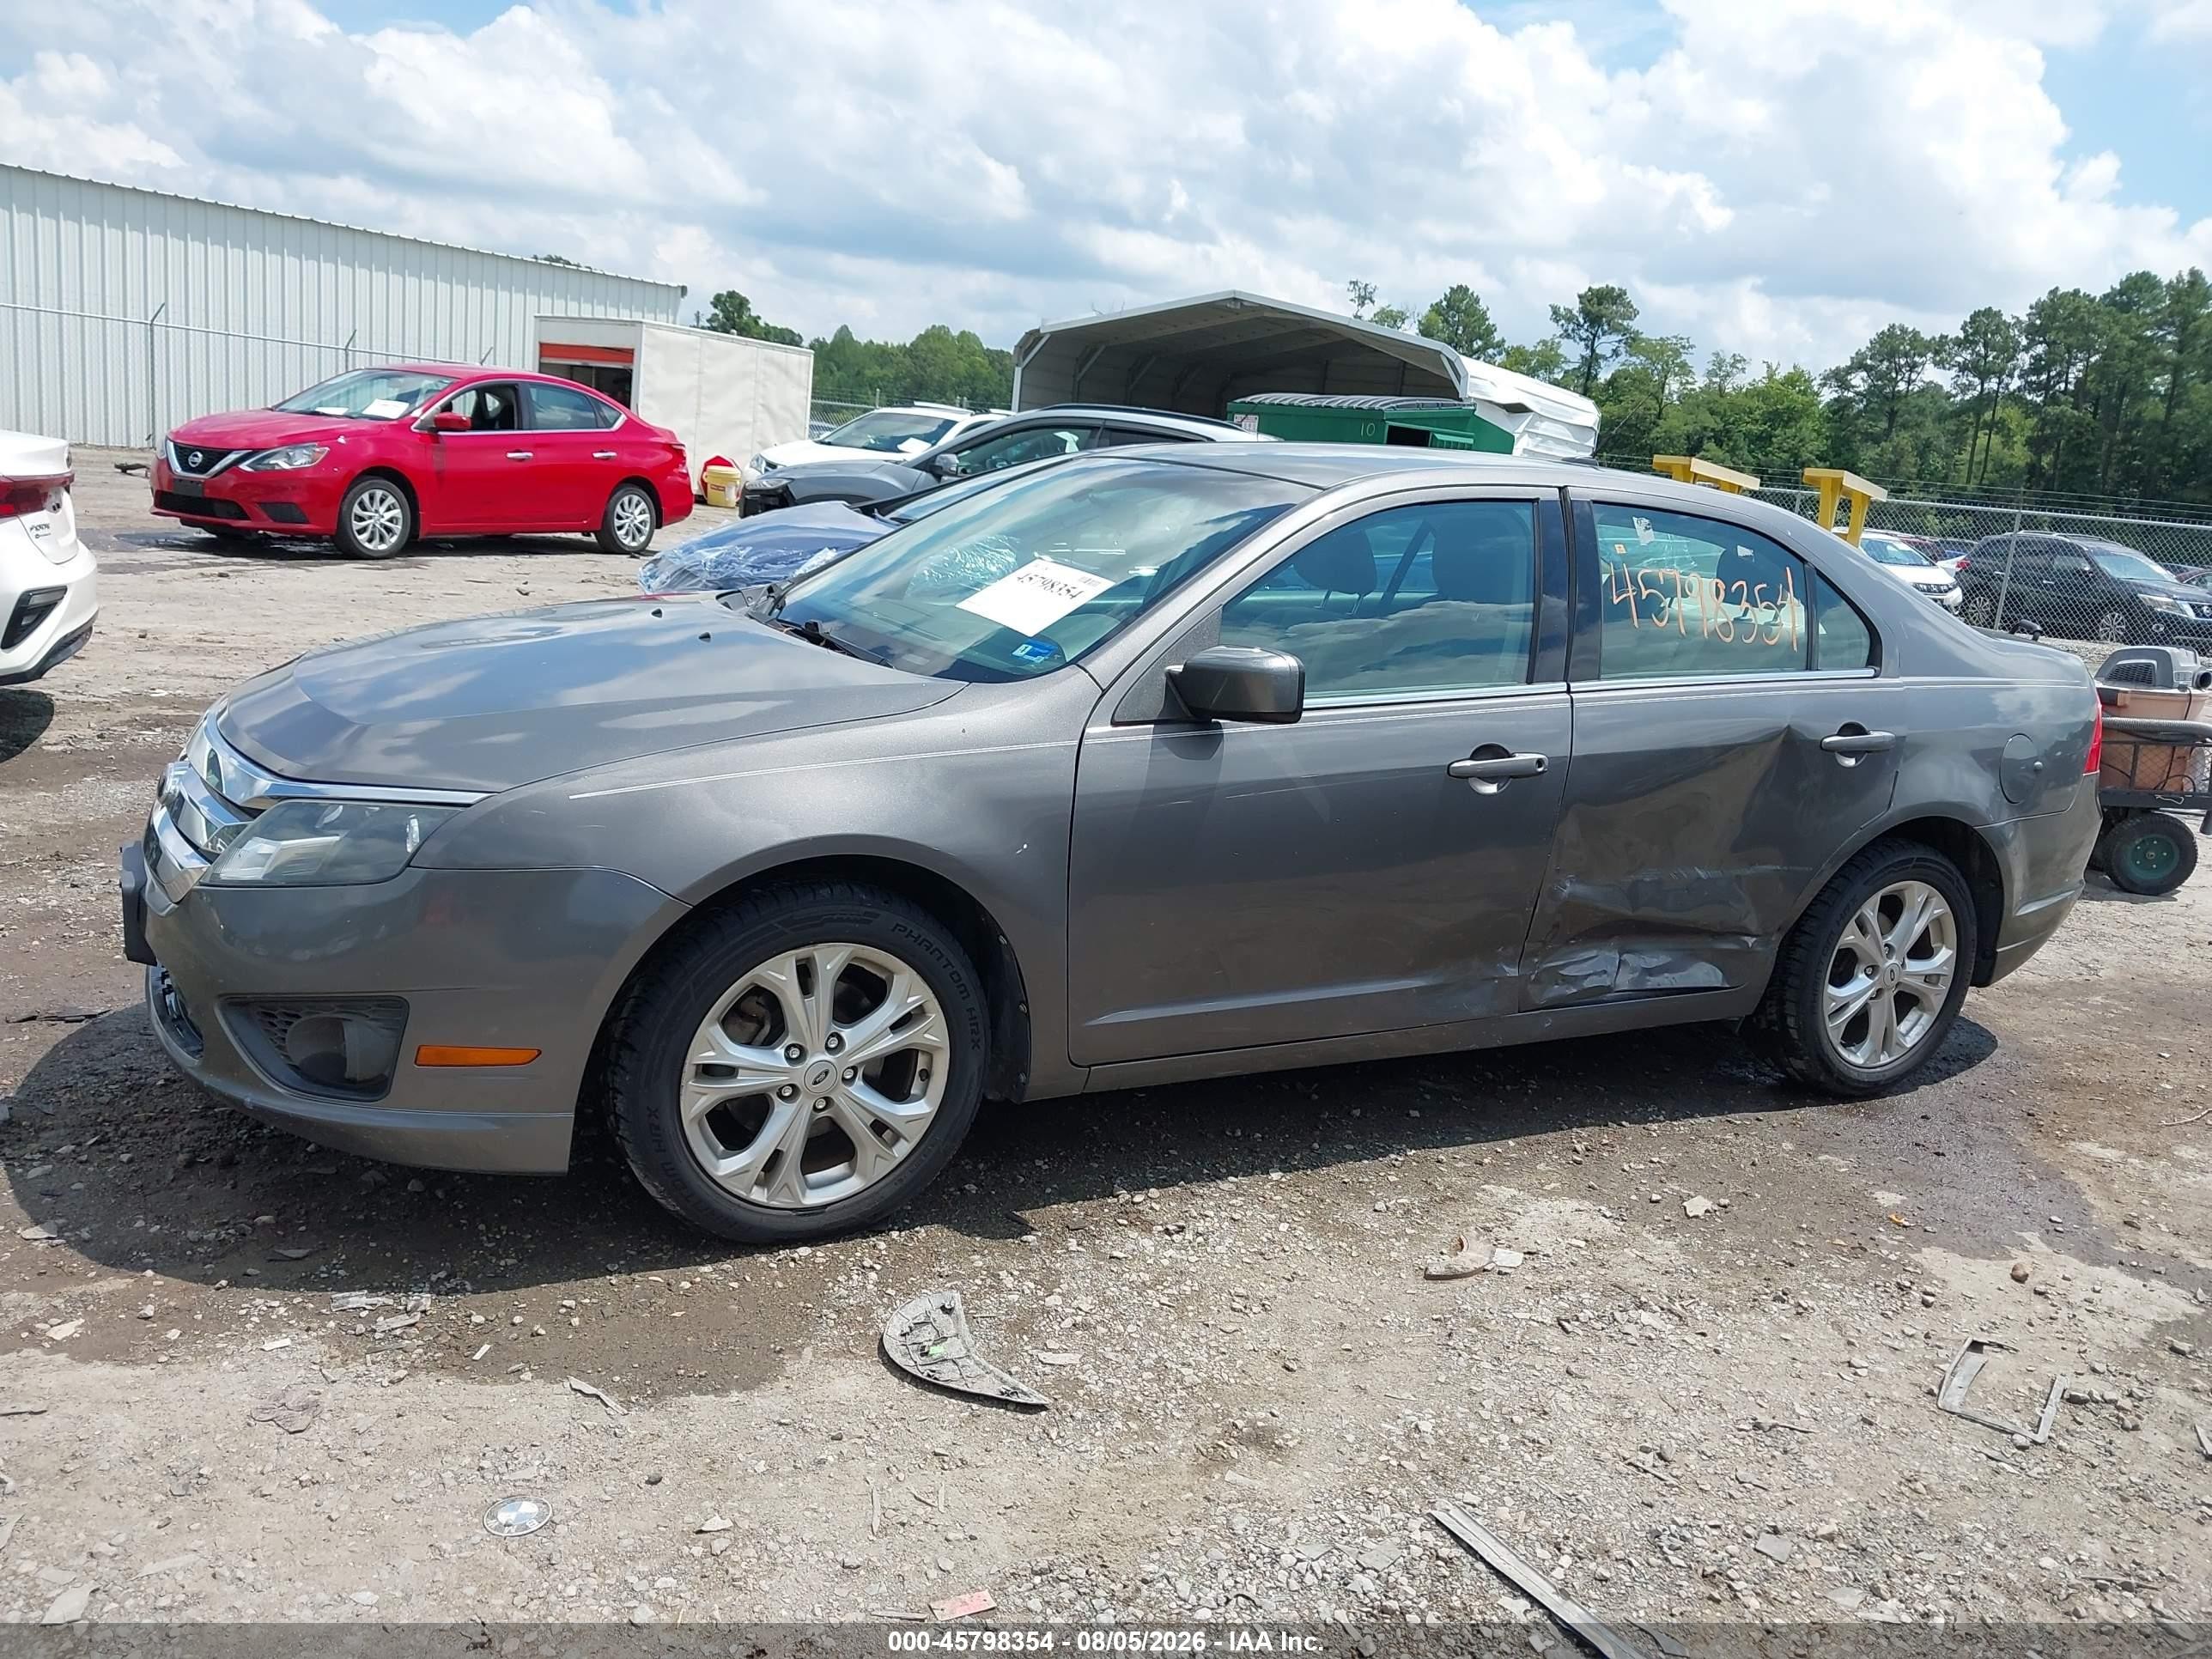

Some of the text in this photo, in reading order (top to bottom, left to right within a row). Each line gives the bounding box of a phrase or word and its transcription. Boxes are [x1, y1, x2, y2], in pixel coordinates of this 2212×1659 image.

[1610, 562, 1800, 653] 45798354
[891, 922, 981, 1050] PHANTOM HRX
